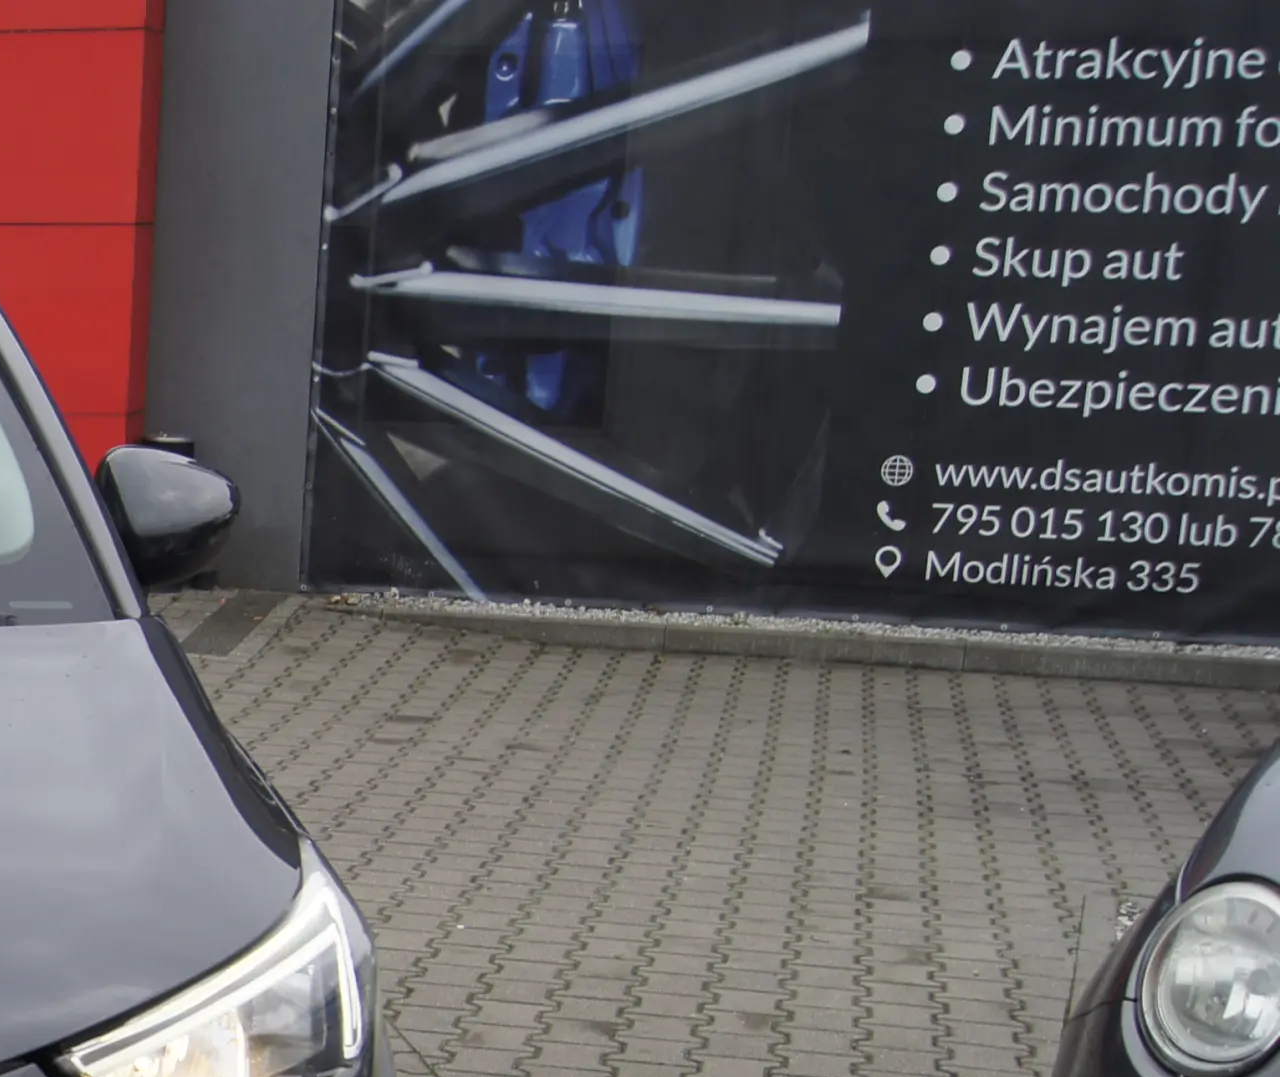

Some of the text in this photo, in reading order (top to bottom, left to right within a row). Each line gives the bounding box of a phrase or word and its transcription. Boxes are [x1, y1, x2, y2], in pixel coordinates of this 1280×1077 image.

[991, 36, 1267, 89] Atrakcyjne
[988, 105, 1223, 147] Minimum
[979, 171, 1268, 224] Samochody
[972, 237, 1185, 288] Skup aut
[967, 302, 1197, 354] Wynajem
[960, 366, 1280, 418] Ubezpieczeni
[932, 503, 1001, 536] 795
[1010, 507, 1084, 540] 015
[1097, 511, 1170, 544] 130
[1178, 512, 1238, 547] lub
[925, 550, 1201, 593] Modlińska 335
